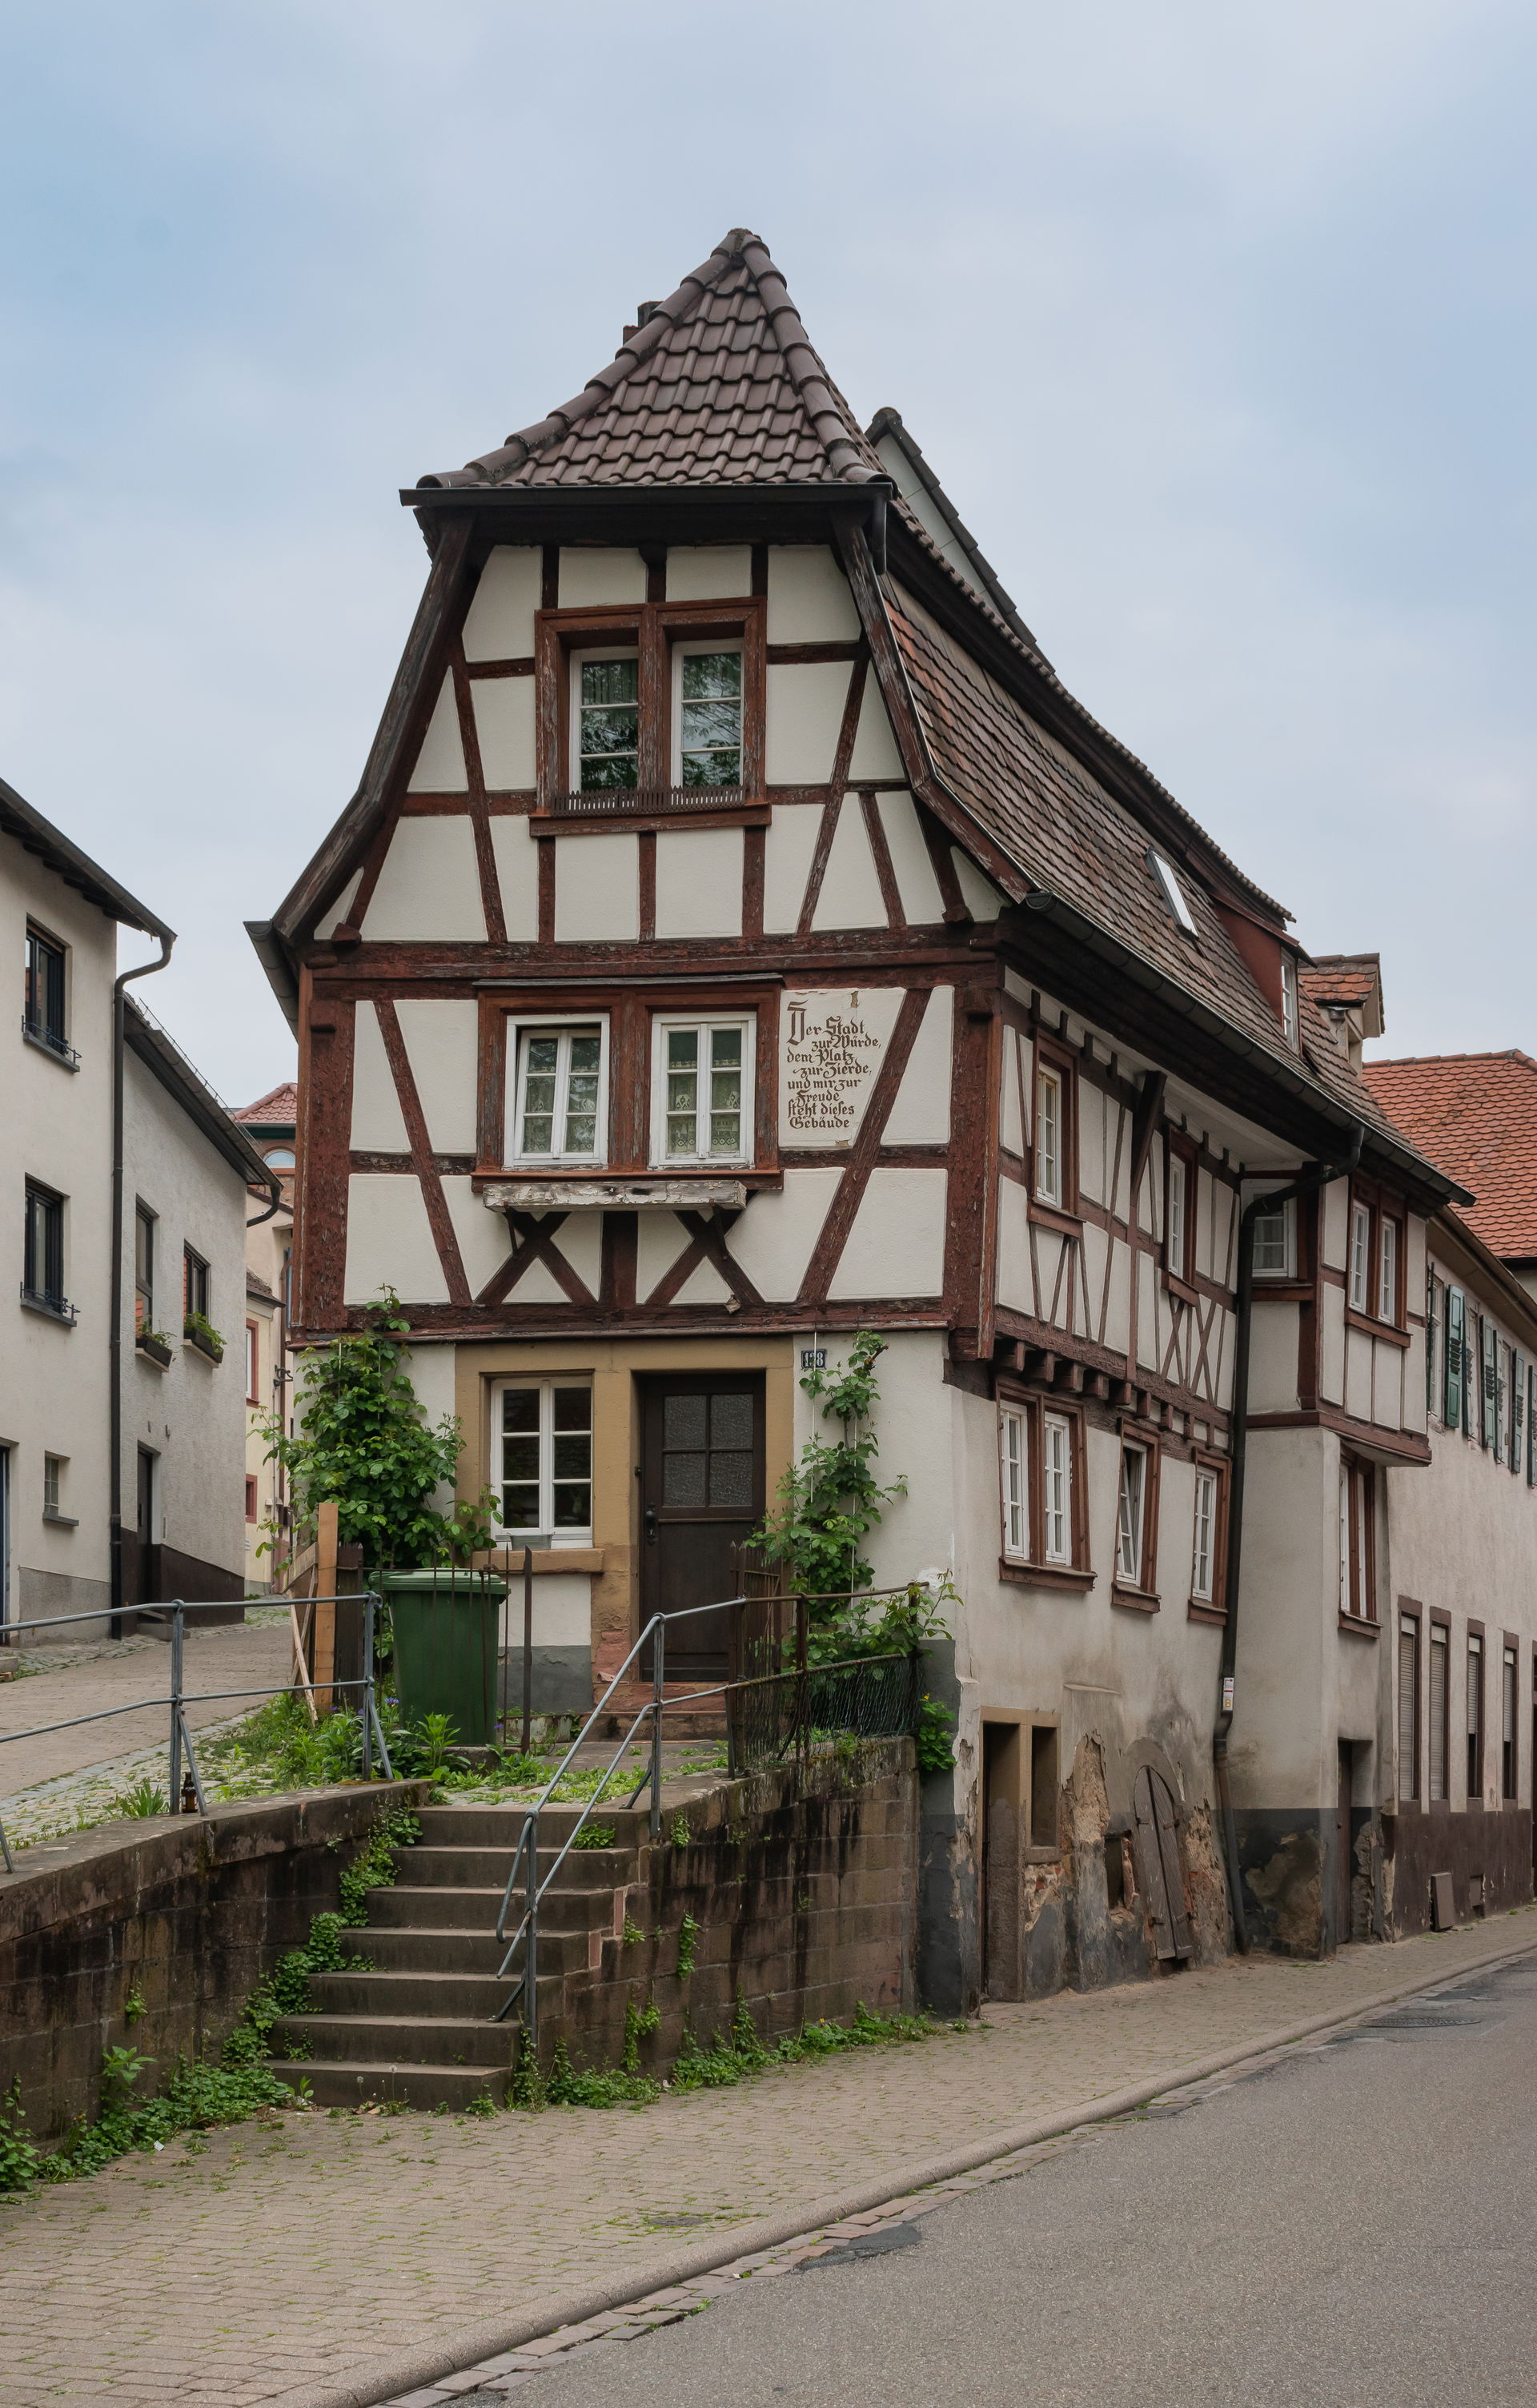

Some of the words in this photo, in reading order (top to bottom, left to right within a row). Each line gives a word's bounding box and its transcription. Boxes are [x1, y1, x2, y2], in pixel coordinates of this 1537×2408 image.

[786, 999, 822, 1046] Der
[822, 1015, 865, 1036] Stadt
[811, 1040, 833, 1052] zur
[830, 1031, 881, 1049] Würde,
[787, 1046, 815, 1064] dem
[815, 1048, 854, 1066] Platz
[793, 1066, 824, 1078] zur
[822, 1058, 872, 1079] Zierde,
[787, 1075, 811, 1090] und
[813, 1079, 837, 1089] mir
[833, 1079, 862, 1092] zur
[796, 1088, 840, 1107] Freude
[789, 1115, 850, 1129] Gebäude
